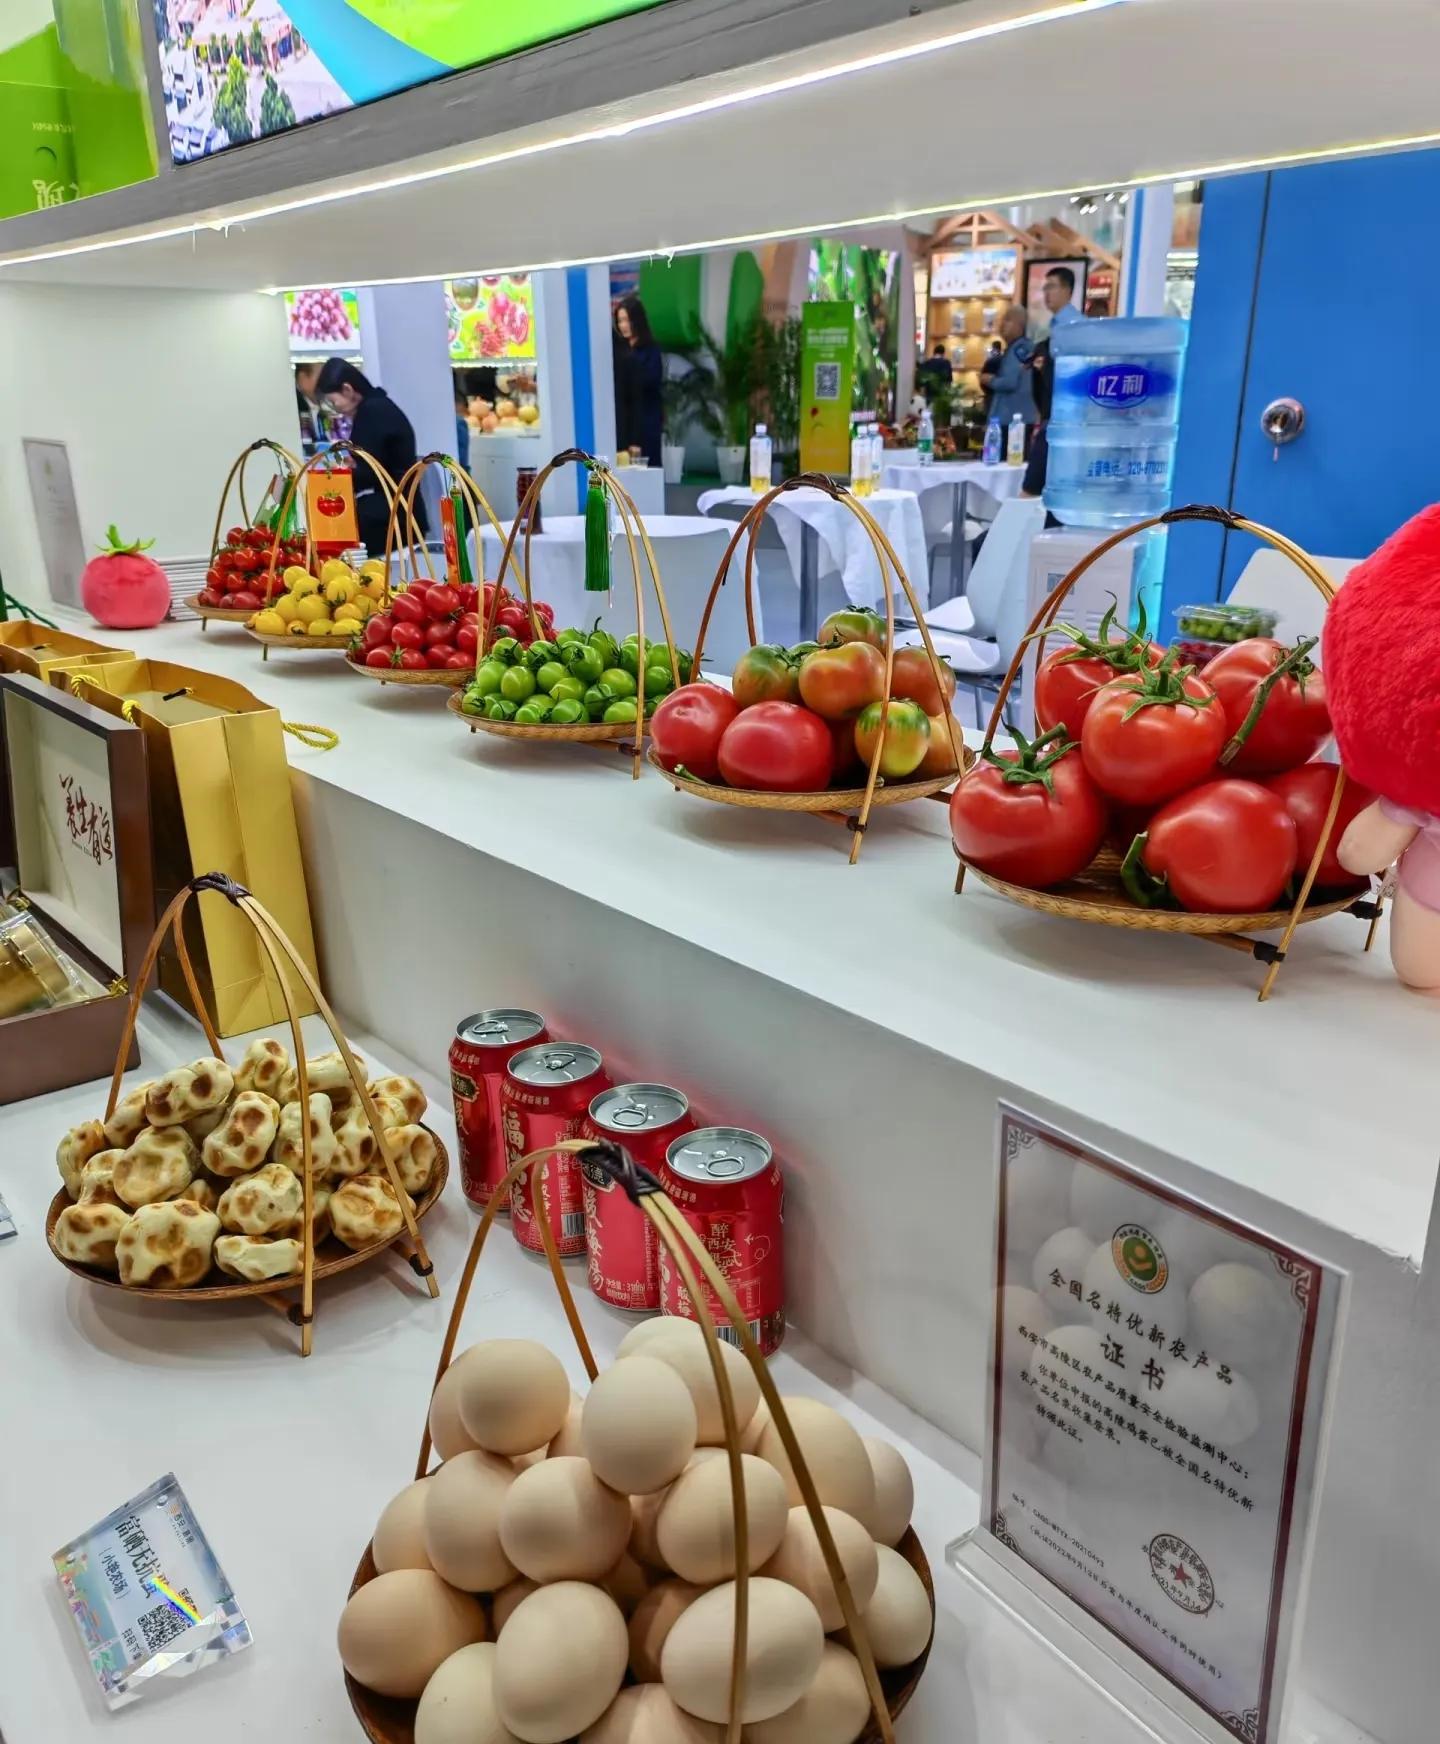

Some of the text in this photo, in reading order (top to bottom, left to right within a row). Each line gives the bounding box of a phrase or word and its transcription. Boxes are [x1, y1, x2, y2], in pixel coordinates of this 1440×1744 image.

[1048, 1266, 1234, 1386] 全国名特优新农产品
